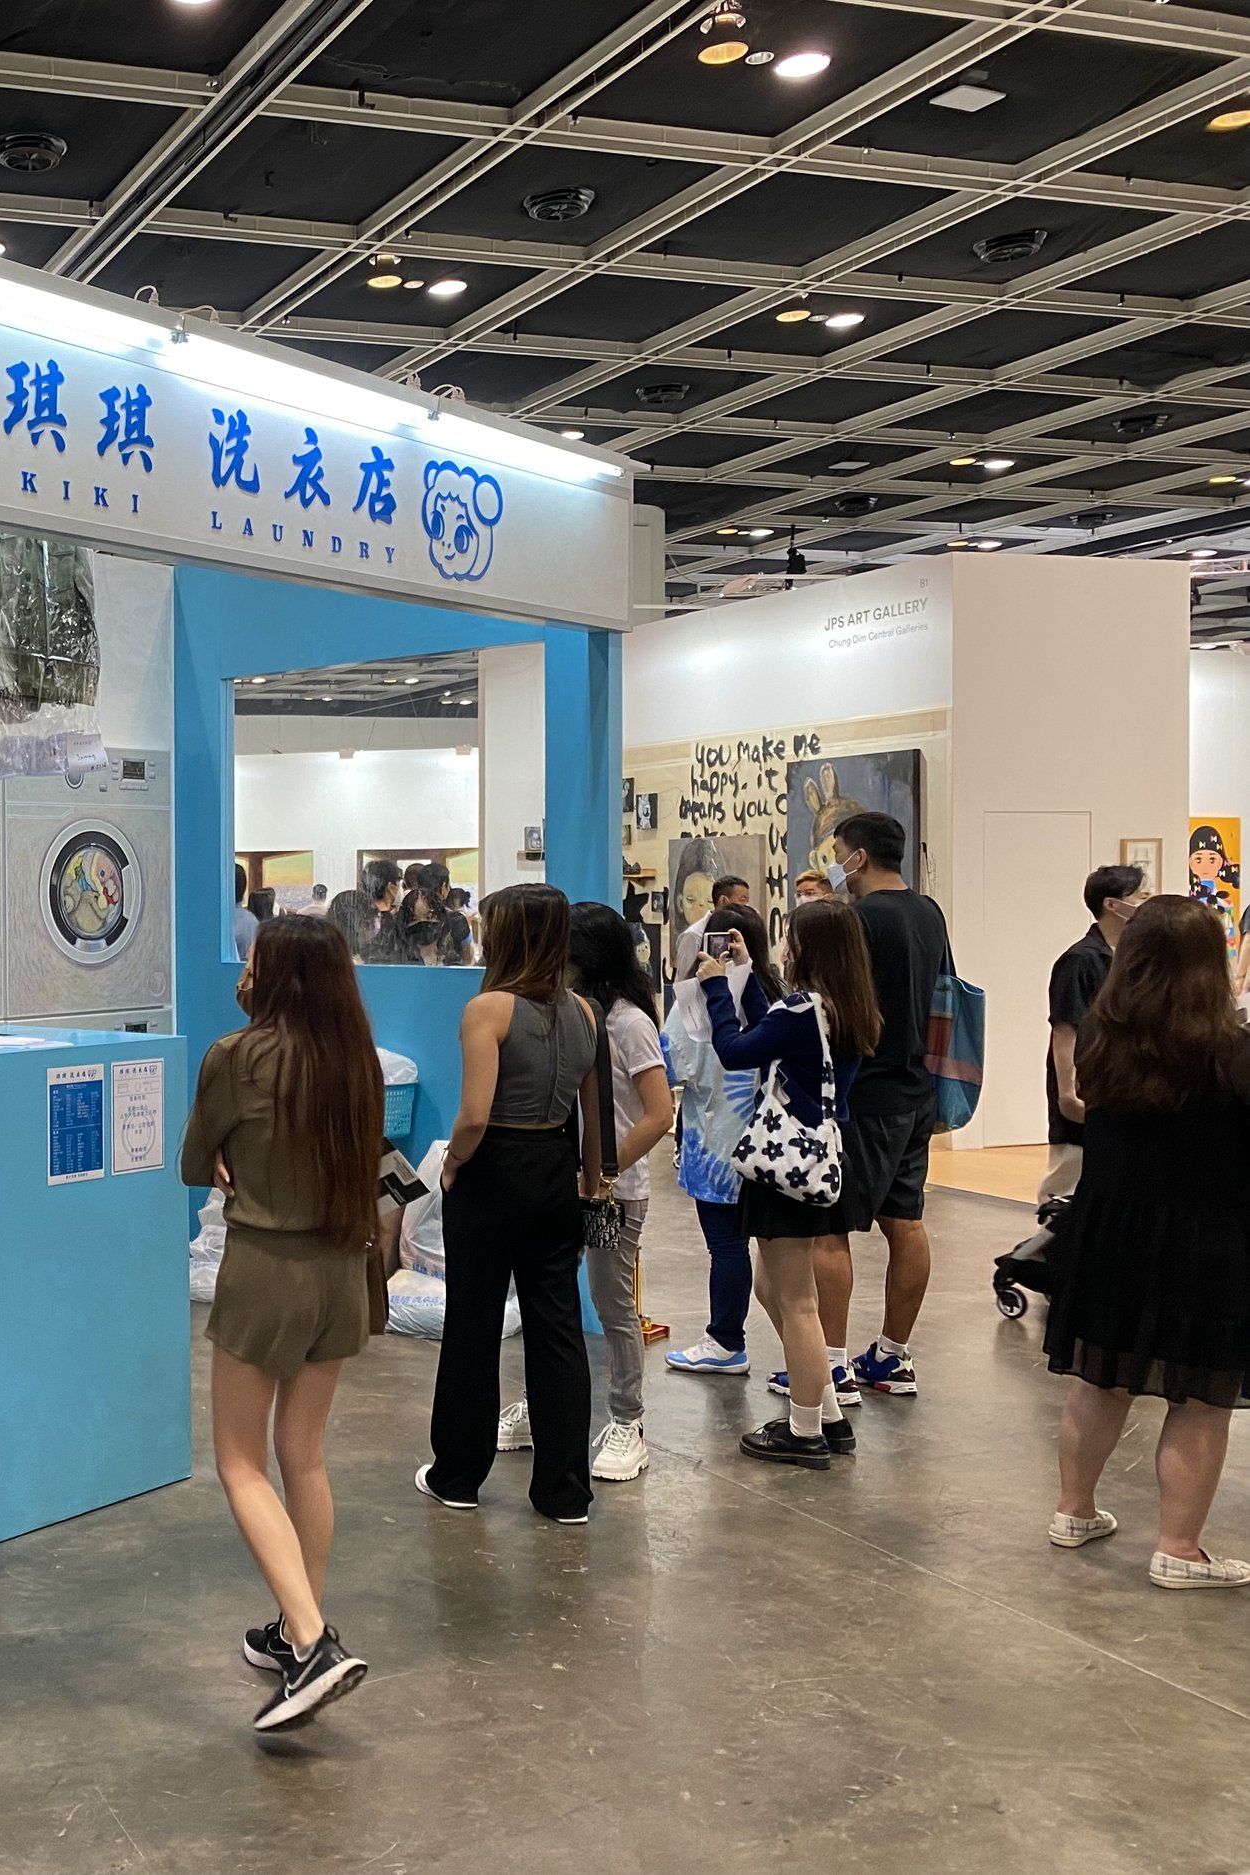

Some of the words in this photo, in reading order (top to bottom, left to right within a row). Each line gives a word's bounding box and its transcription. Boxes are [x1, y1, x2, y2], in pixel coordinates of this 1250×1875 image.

[3, 358, 155, 474] 琪琪
[208, 407, 399, 526] 洗衣店
[20, 470, 139, 514] KIKI
[211, 509, 398, 565] LAUNDRY
[824, 615, 845, 632] JPS
[847, 610, 871, 627] ART
[873, 597, 928, 621] GALLERY
[868, 627, 895, 641] Central
